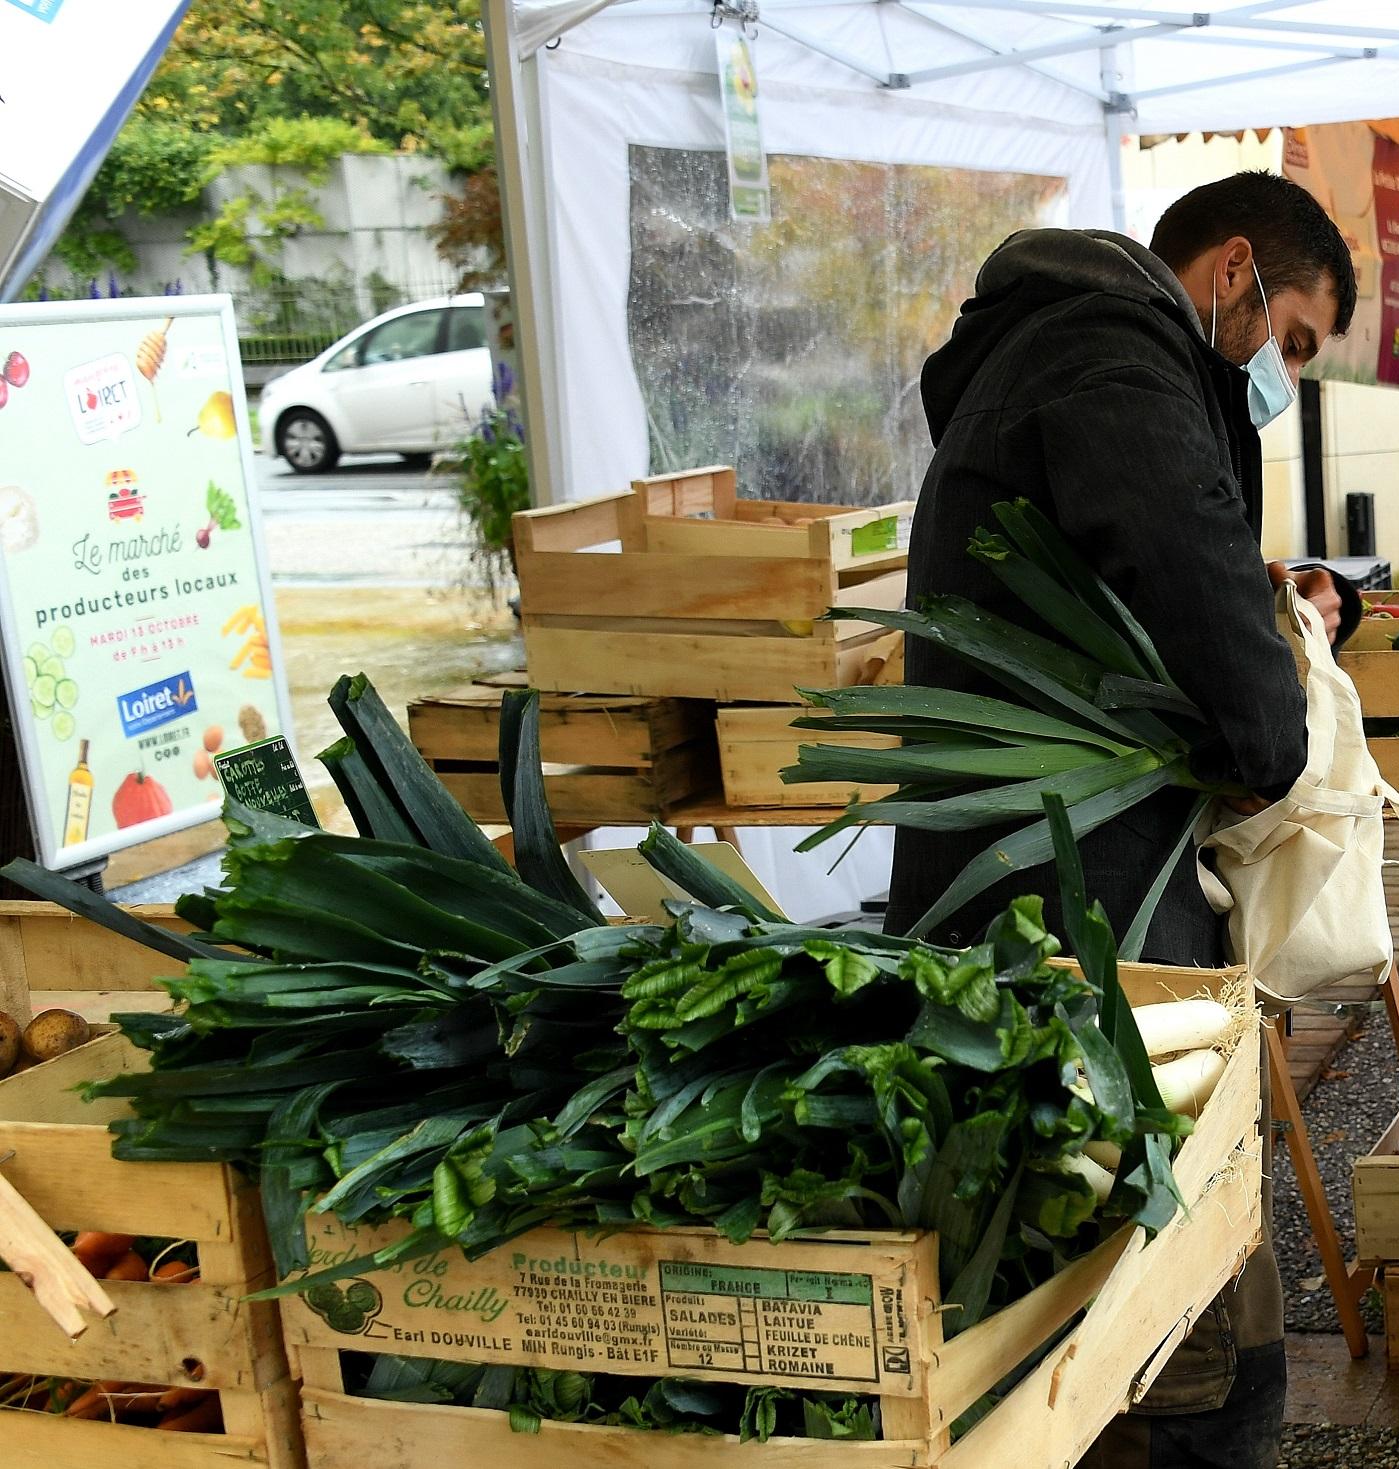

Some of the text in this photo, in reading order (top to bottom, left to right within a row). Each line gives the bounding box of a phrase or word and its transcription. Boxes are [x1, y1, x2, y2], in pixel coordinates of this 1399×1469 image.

[72, 523, 183, 575] Le marché
[122, 567, 150, 582] des
[36, 572, 238, 629] producteurs locaux
[90, 629, 128, 648] MARDI
[148, 615, 199, 634] OCTOBRE
[121, 687, 174, 722] Loiret
[414, 1252, 449, 1277] de
[512, 1252, 649, 1280] Producteur
[664, 1265, 712, 1278] ORIGINE:
[520, 1272, 647, 1293] 7 Rue de la Fromagerie
[711, 1279, 761, 1294] FRANCE
[403, 1279, 509, 1322] Chailly
[513, 1286, 656, 1306] 77930 CHAILLY EN BIERE
[665, 1294, 705, 1306] Produit:
[537, 1301, 637, 1319] Tel: 01 60 66 42 39
[669, 1309, 737, 1326] SALADES
[762, 1300, 823, 1316] BATAVIA
[516, 1312, 660, 1337] Tel: 01 45 60 94 03 (Rungis)
[763, 1315, 815, 1330] LAITUE
[394, 1328, 513, 1351] Earl DOUVILLE
[525, 1327, 654, 1347] earldouville@gmx.fr
[669, 1327, 707, 1339] Variété:
[765, 1329, 871, 1348] FEUILLE DE CHÊNE
[521, 1339, 546, 1354] MIN
[551, 1341, 595, 1360] Rungis
[607, 1346, 630, 1361] Bât
[633, 1348, 659, 1363] E1F
[670, 1341, 739, 1355] Nombre ou Masse
[767, 1344, 817, 1359] KRIZET
[699, 1353, 713, 1366] 12
[768, 1358, 835, 1375] ROMAINE
